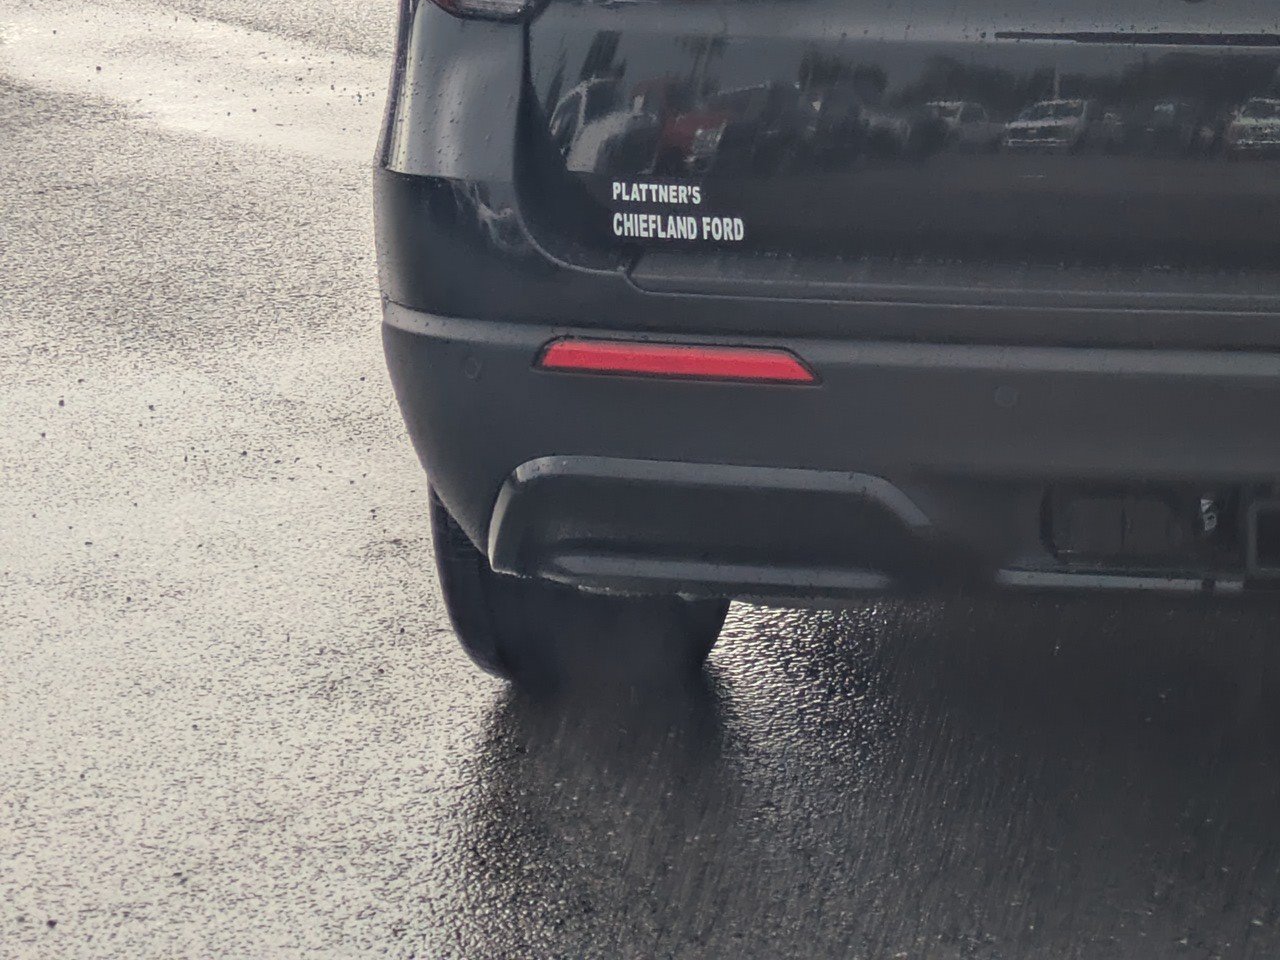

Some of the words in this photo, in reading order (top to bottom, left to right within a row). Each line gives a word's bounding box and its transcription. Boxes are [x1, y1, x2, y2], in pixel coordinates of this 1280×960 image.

[612, 181, 702, 205] PLATTNER'S
[613, 212, 698, 240] CHIEFLAND
[702, 216, 745, 241] FORD
